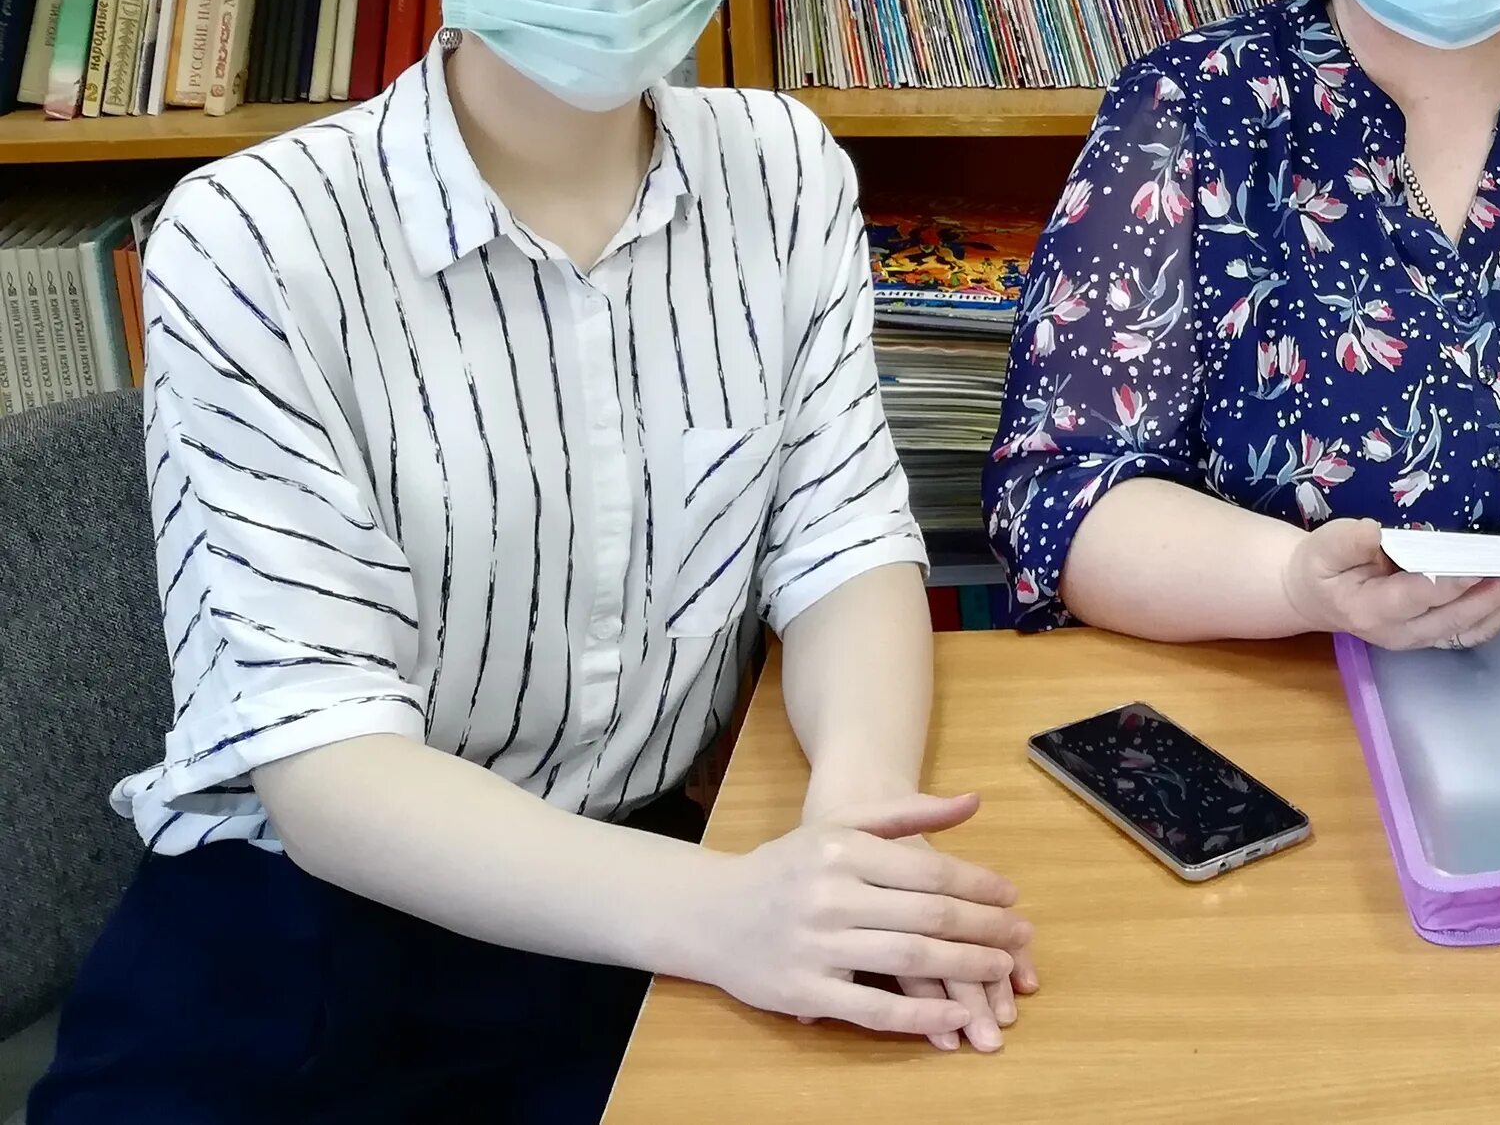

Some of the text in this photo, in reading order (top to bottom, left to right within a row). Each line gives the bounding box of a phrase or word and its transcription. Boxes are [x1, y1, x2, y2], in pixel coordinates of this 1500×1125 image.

[89, 0, 109, 72] народные
[188, 26, 209, 89] РУССКИЕ
[934, 292, 997, 302] ОГНЕМ
